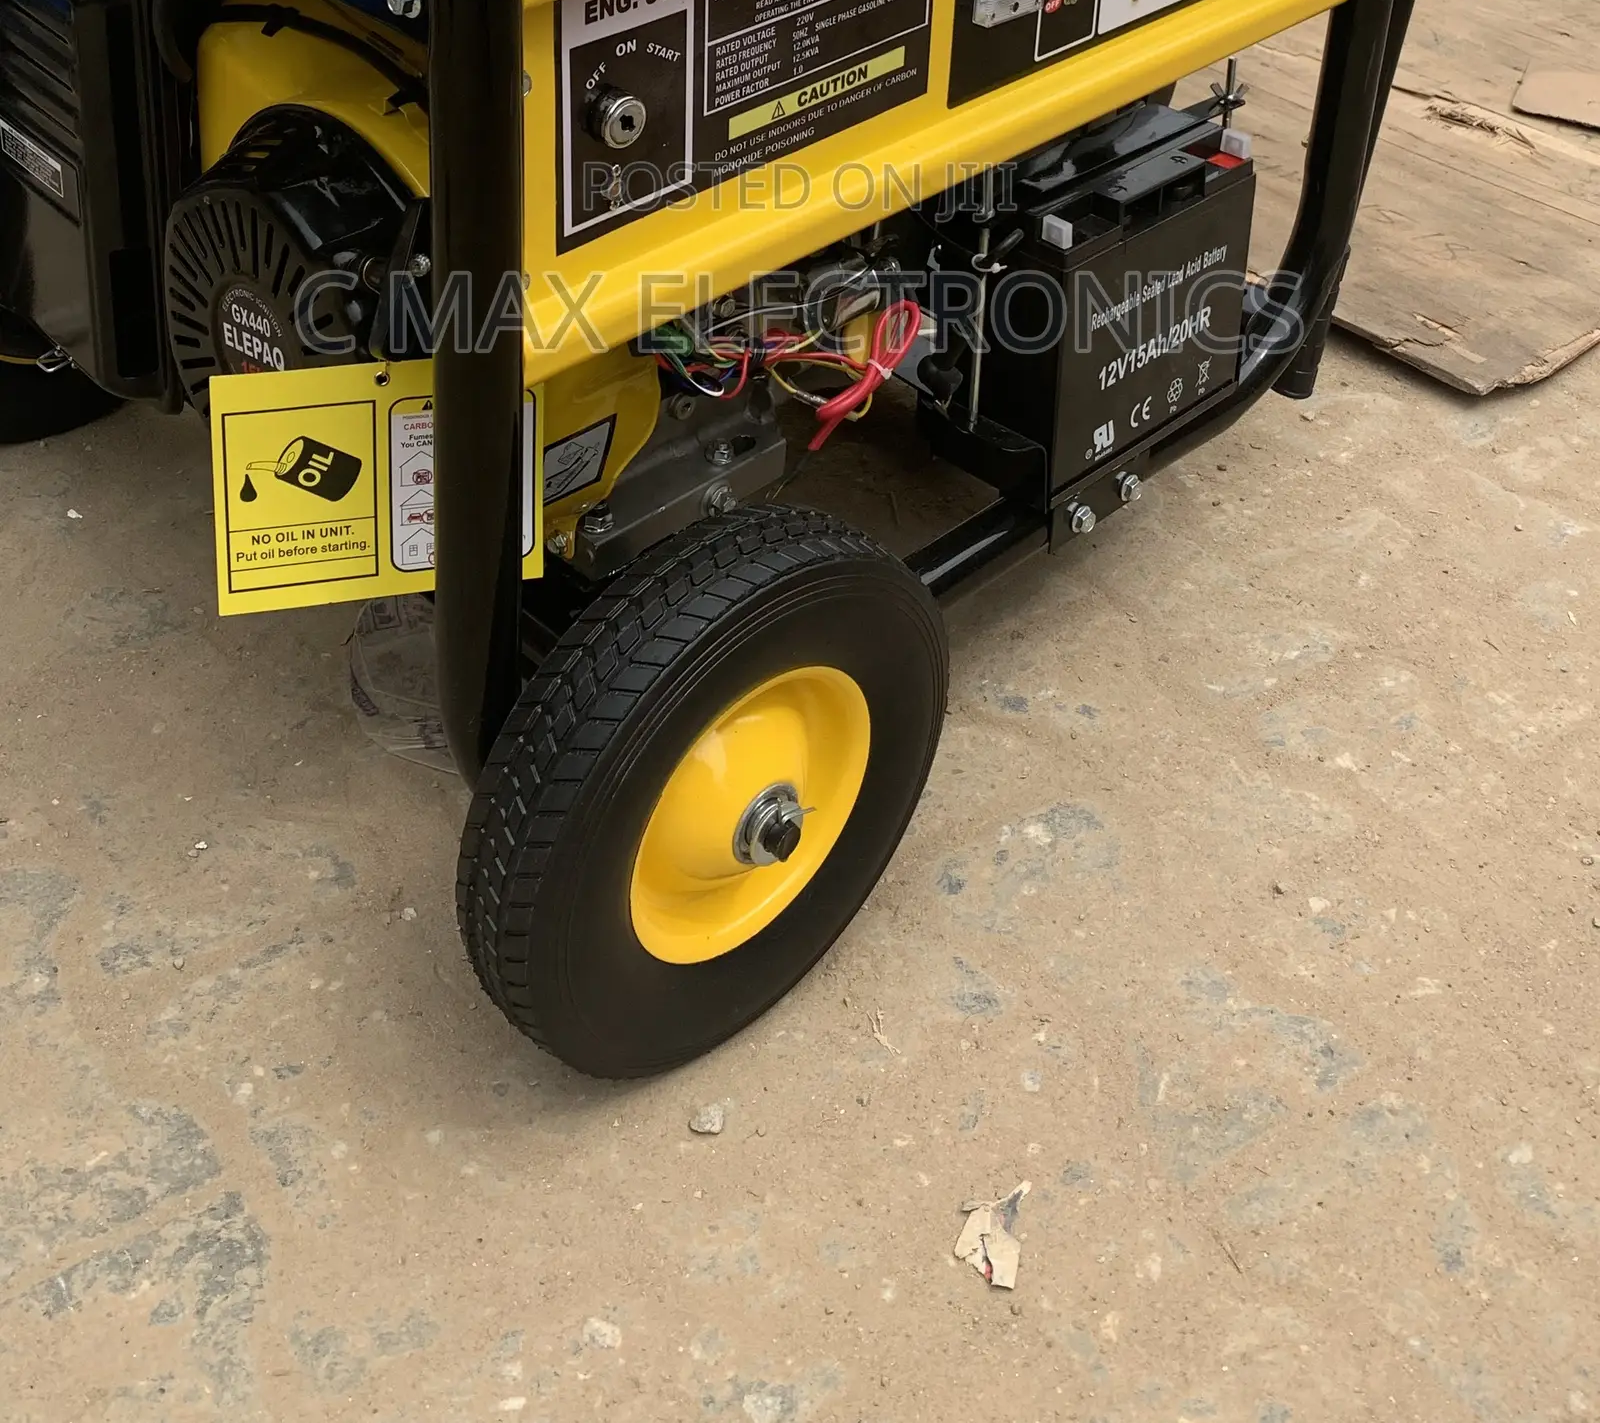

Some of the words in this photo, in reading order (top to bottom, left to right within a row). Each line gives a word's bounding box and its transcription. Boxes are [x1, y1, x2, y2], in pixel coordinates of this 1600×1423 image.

[754, 3, 789, 23] OPERATING
[1045, 0, 1060, 11] OFF
[715, 54, 737, 70] RATED
[738, 38, 777, 63] FREQUENCY
[792, 28, 808, 41] 50HZ
[814, 17, 837, 32] SINGLE
[837, 8, 857, 23] PHASE
[716, 41, 741, 57] RATED
[743, 27, 776, 47] VOLTAGE
[796, 12, 814, 26] 220V
[585, 61, 608, 90] OFF
[615, 39, 637, 57] ON
[646, 42, 681, 62] START
[714, 91, 741, 108] POWER
[741, 78, 770, 100] FACTOR
[793, 65, 804, 77] 1.0
[715, 66, 739, 82] RATED
[740, 53, 769, 74] OUTPUT
[715, 75, 751, 94] MAXIMUM
[752, 61, 781, 79] OUTPUT
[793, 46, 820, 64] 12.5KVA
[797, 65, 869, 107] CAUTION
[714, 150, 728, 162] DO
[729, 141, 747, 155] NOT
[750, 132, 767, 147] USE
[768, 116, 806, 139] INDOORS
[808, 109, 825, 123] DUE
[827, 101, 838, 112] TO
[839, 86, 872, 108] DANGER
[873, 81, 883, 93] OF
[885, 67, 917, 87] CARBON
[713, 149, 763, 178] MONOXIDE
[765, 127, 815, 155] POISONING
[1091, 291, 1140, 332] Rechargeable
[1142, 275, 1167, 303] Sealed
[1167, 265, 1184, 288] Lead
[1185, 254, 1201, 279] Acid
[1203, 245, 1227, 269] Battery
[222, 289, 254, 312] ELECTRONIC
[256, 298, 283, 337] IGNITION
[231, 303, 271, 337] GX440
[223, 322, 284, 371] ELEPAQ
[1098, 306, 1211, 391] 12V15Ah/20HR
[1130, 396, 1152, 428] CE
[298, 451, 334, 487] OIL
[236, 551, 258, 562] Put
[260, 548, 275, 560] oil
[278, 545, 318, 558] before
[321, 540, 371, 554] starting.
[251, 534, 271, 546] NO
[275, 531, 298, 543] OIL
[302, 529, 315, 540] IN
[320, 525, 355, 538] UNIT.
